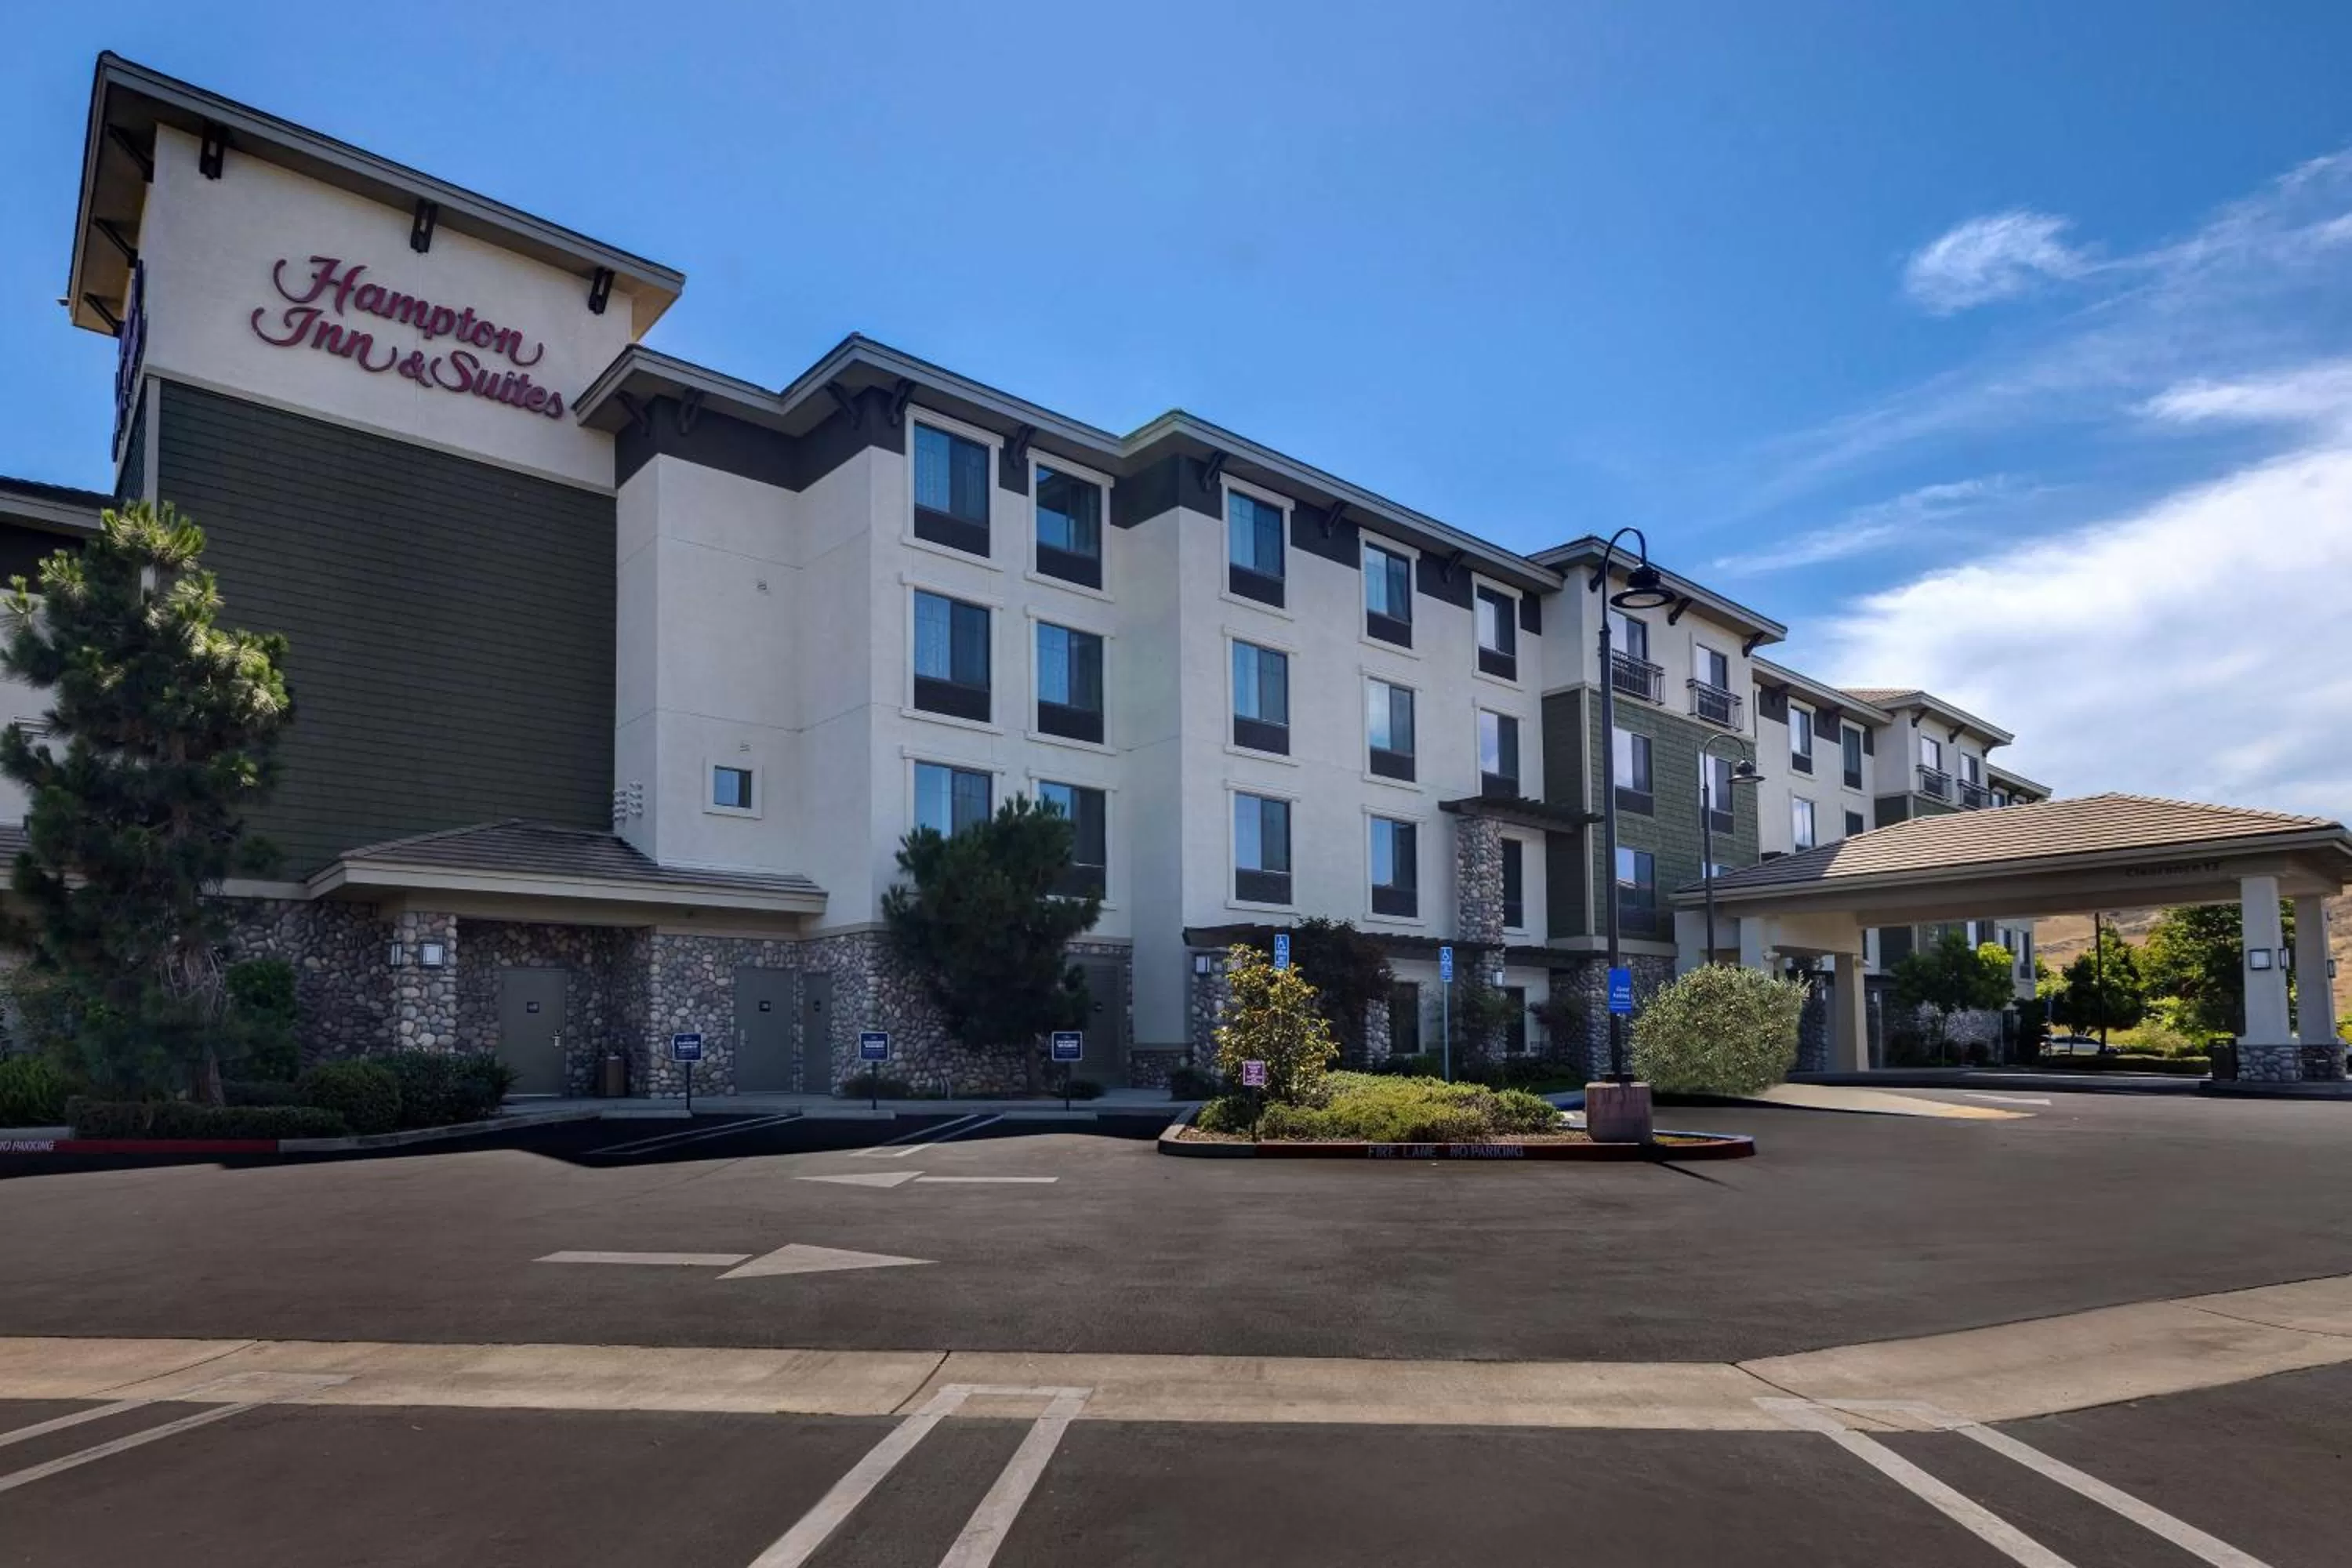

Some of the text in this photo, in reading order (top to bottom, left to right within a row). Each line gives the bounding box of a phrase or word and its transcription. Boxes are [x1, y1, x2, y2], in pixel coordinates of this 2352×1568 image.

[251, 306, 564, 419] Inn & Suites
[273, 255, 543, 366] Hampton
[1368, 1145, 1397, 1158] FIRE
[1450, 1145, 1468, 1158] NO
[1472, 1144, 1525, 1158] PARKING
